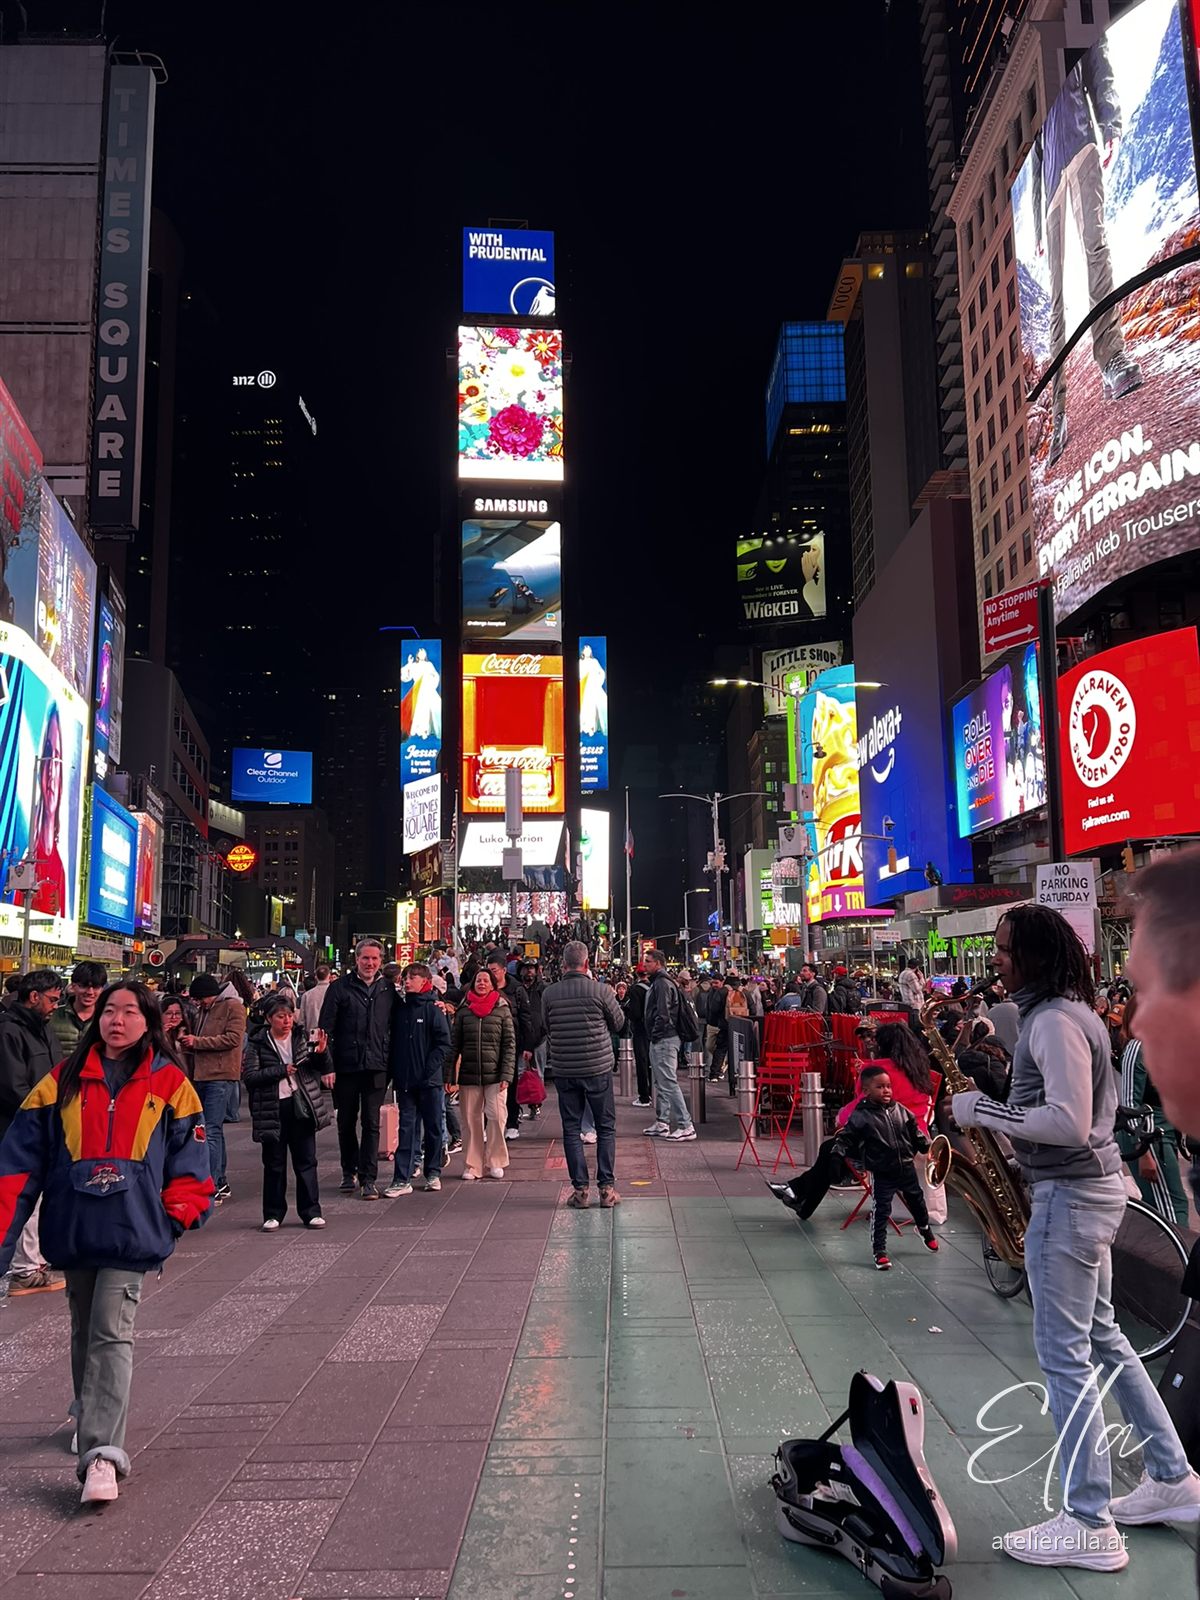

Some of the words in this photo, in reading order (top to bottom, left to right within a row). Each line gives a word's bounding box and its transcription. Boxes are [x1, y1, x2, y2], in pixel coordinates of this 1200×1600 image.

[106, 88, 137, 253] TIMES
[468, 232, 503, 246] WITH
[468, 245, 547, 262] PRUDENTIAL
[98, 282, 130, 497] SQUARE
[1053, 470, 1084, 522] ONE
[1084, 424, 1153, 490] ICON.
[474, 498, 549, 513] SAMSUNG
[1038, 512, 1080, 576] EVERY
[1082, 443, 1200, 531] TERRAIN
[1096, 530, 1120, 560] Keb
[985, 603, 998, 616] NO
[999, 587, 1038, 610] STOPPING
[987, 609, 1020, 627] Anytime
[480, 653, 544, 674] Coca-Cola
[770, 648, 807, 673] LITTLE
[808, 648, 837, 665] SHOP
[868, 705, 902, 760] alexa+
[963, 710, 992, 748] ROLL
[580, 742, 604, 755] esus
[964, 735, 992, 770] OVER
[1109, 723, 1131, 766] 1960
[246, 768, 267, 776] Clear
[267, 769, 299, 777] Channel
[978, 759, 995, 784] DIE
[1073, 743, 1109, 782] SWEDEN
[257, 776, 287, 784] Outdoor
[419, 798, 438, 814] TIMES
[405, 812, 440, 840] SQUARE
[479, 835, 504, 844] Luko
[1054, 864, 1070, 876] NO
[1041, 877, 1089, 890] PARKING
[460, 901, 510, 915] FROM
[1040, 892, 1090, 903] SATURDAY
[400, 945, 413, 968] tkts
